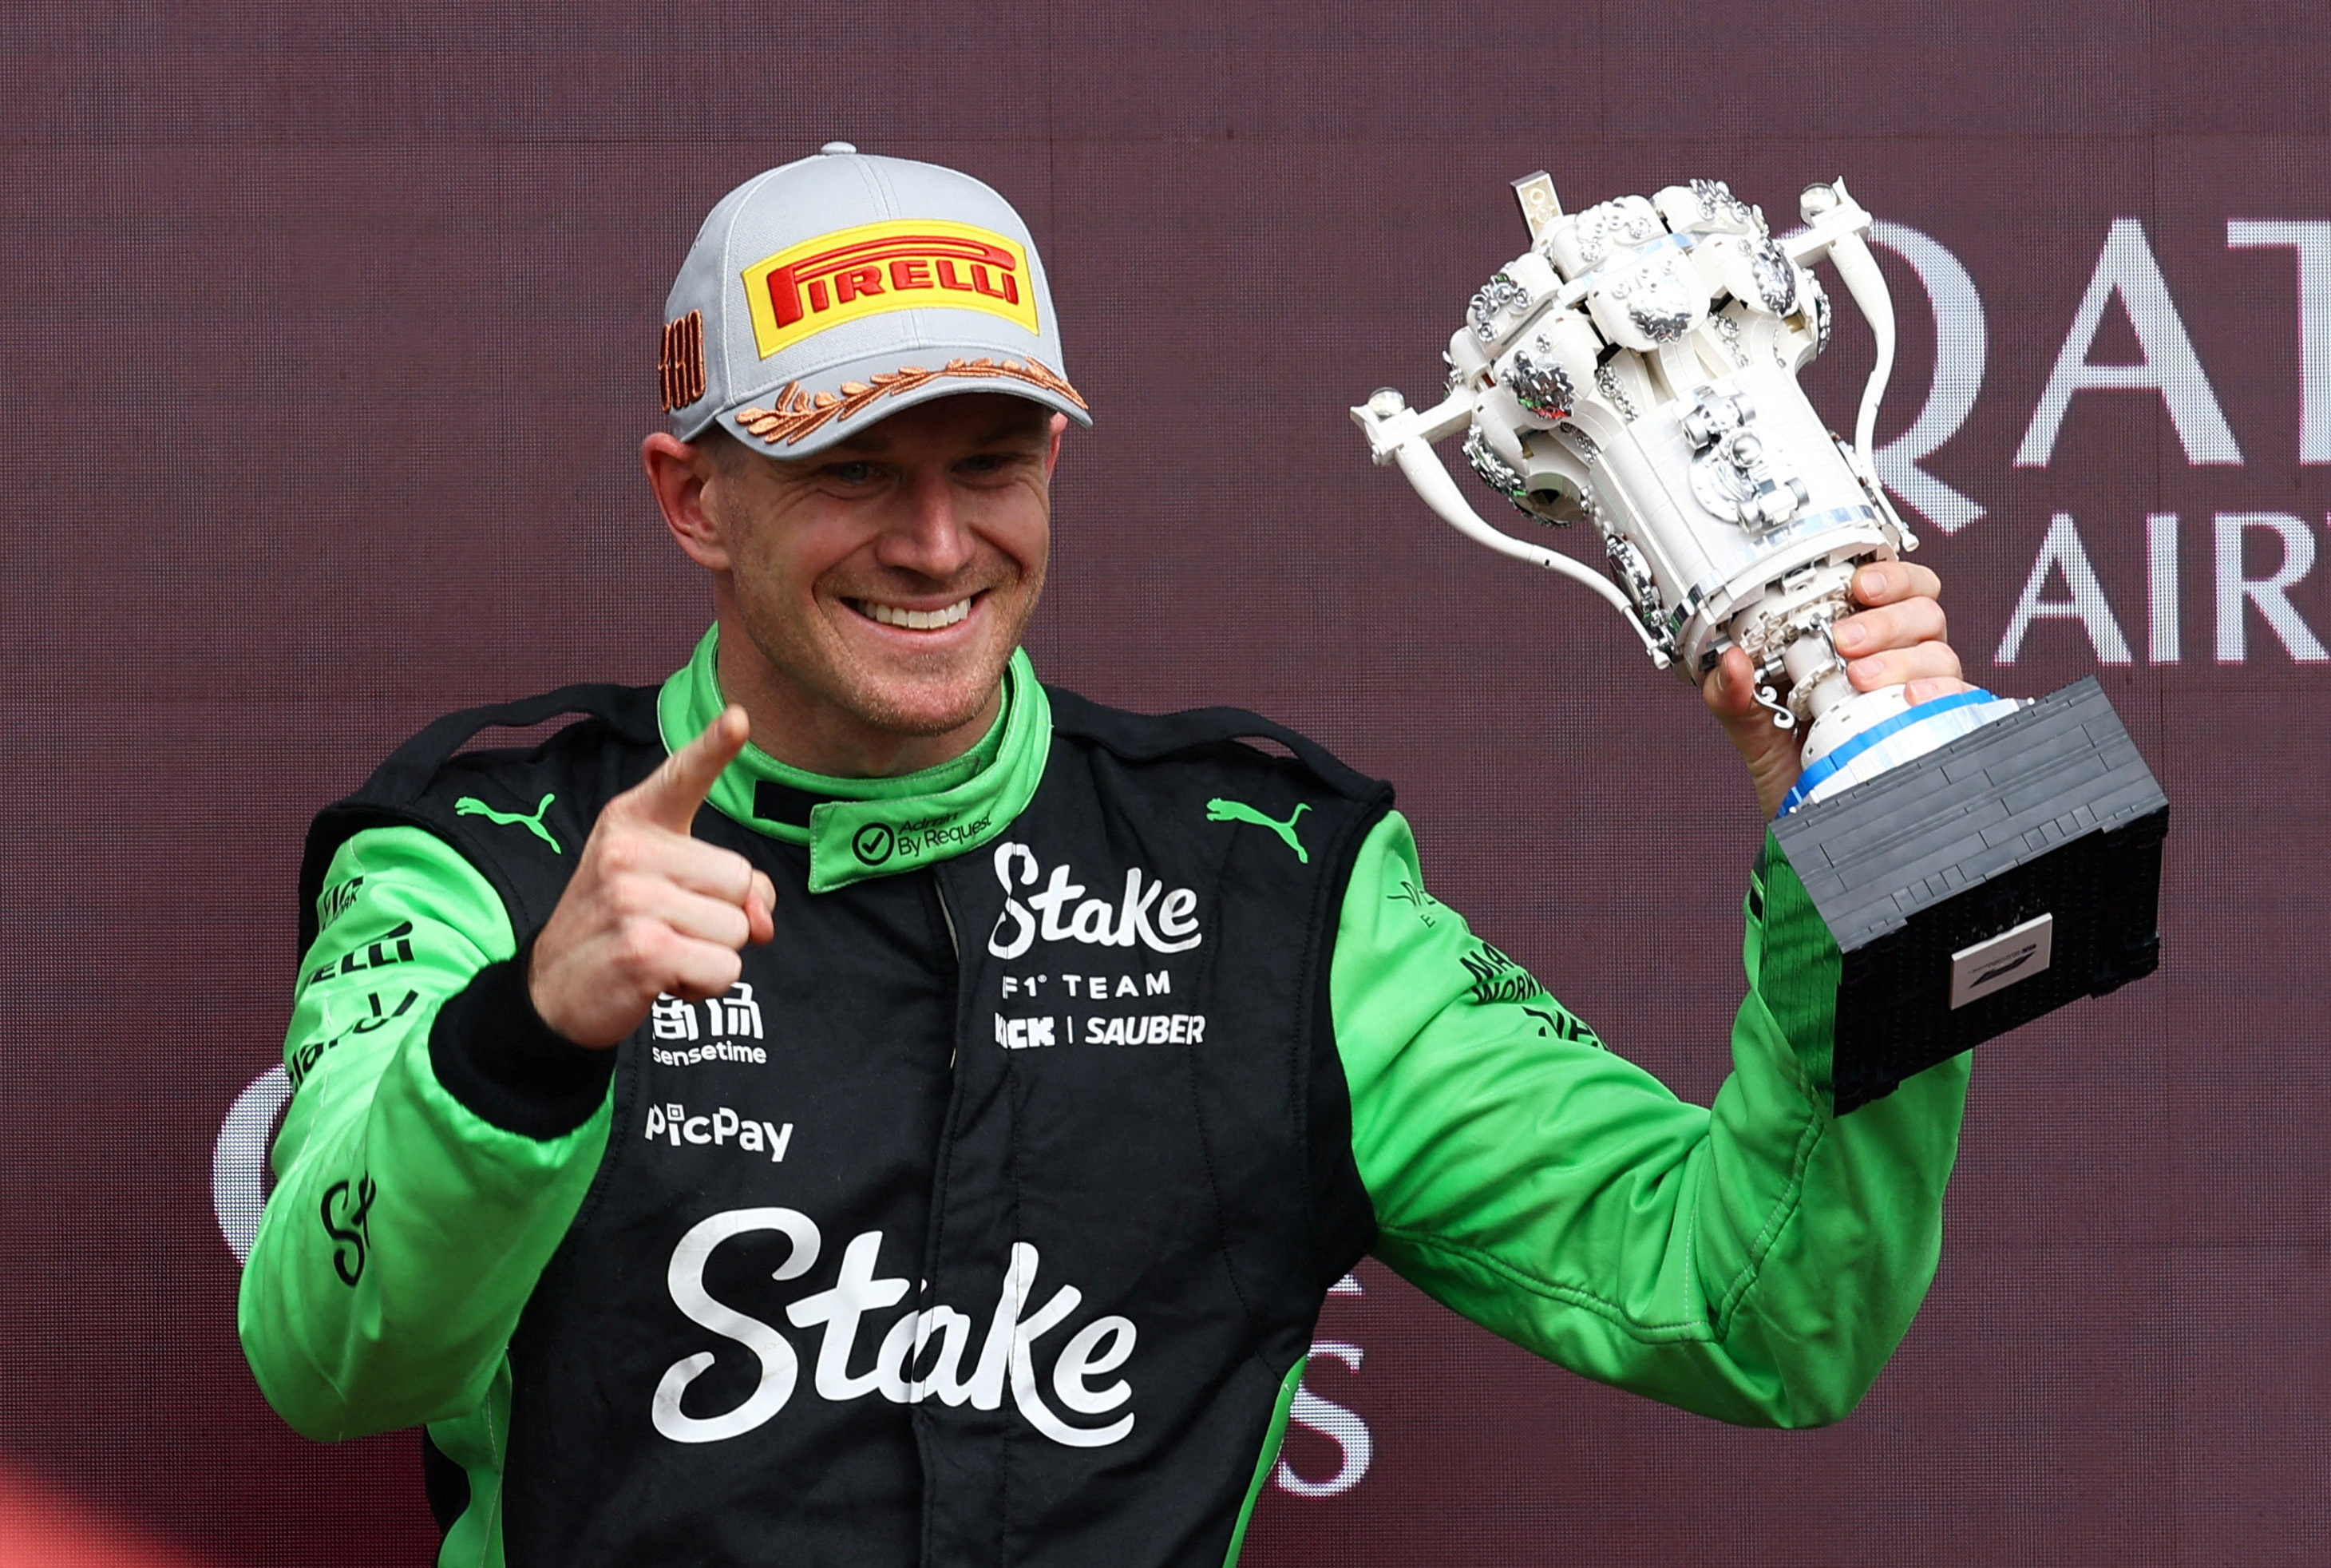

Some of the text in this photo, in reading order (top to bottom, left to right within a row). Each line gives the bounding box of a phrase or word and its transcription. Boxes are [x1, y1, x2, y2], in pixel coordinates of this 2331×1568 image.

[766, 235, 1019, 329] PIRELLI
[1993, 512, 2331, 664] AIR
[897, 810, 991, 858] By Request
[898, 812, 959, 835] Admin
[987, 841, 1202, 960] Stake
[309, 921, 415, 986] ELLI
[1062, 969, 1171, 1000] TEAM
[651, 1039, 767, 1067] sensetime
[1084, 1014, 1206, 1047] SAUBER
[651, 1206, 1138, 1447] Stake
